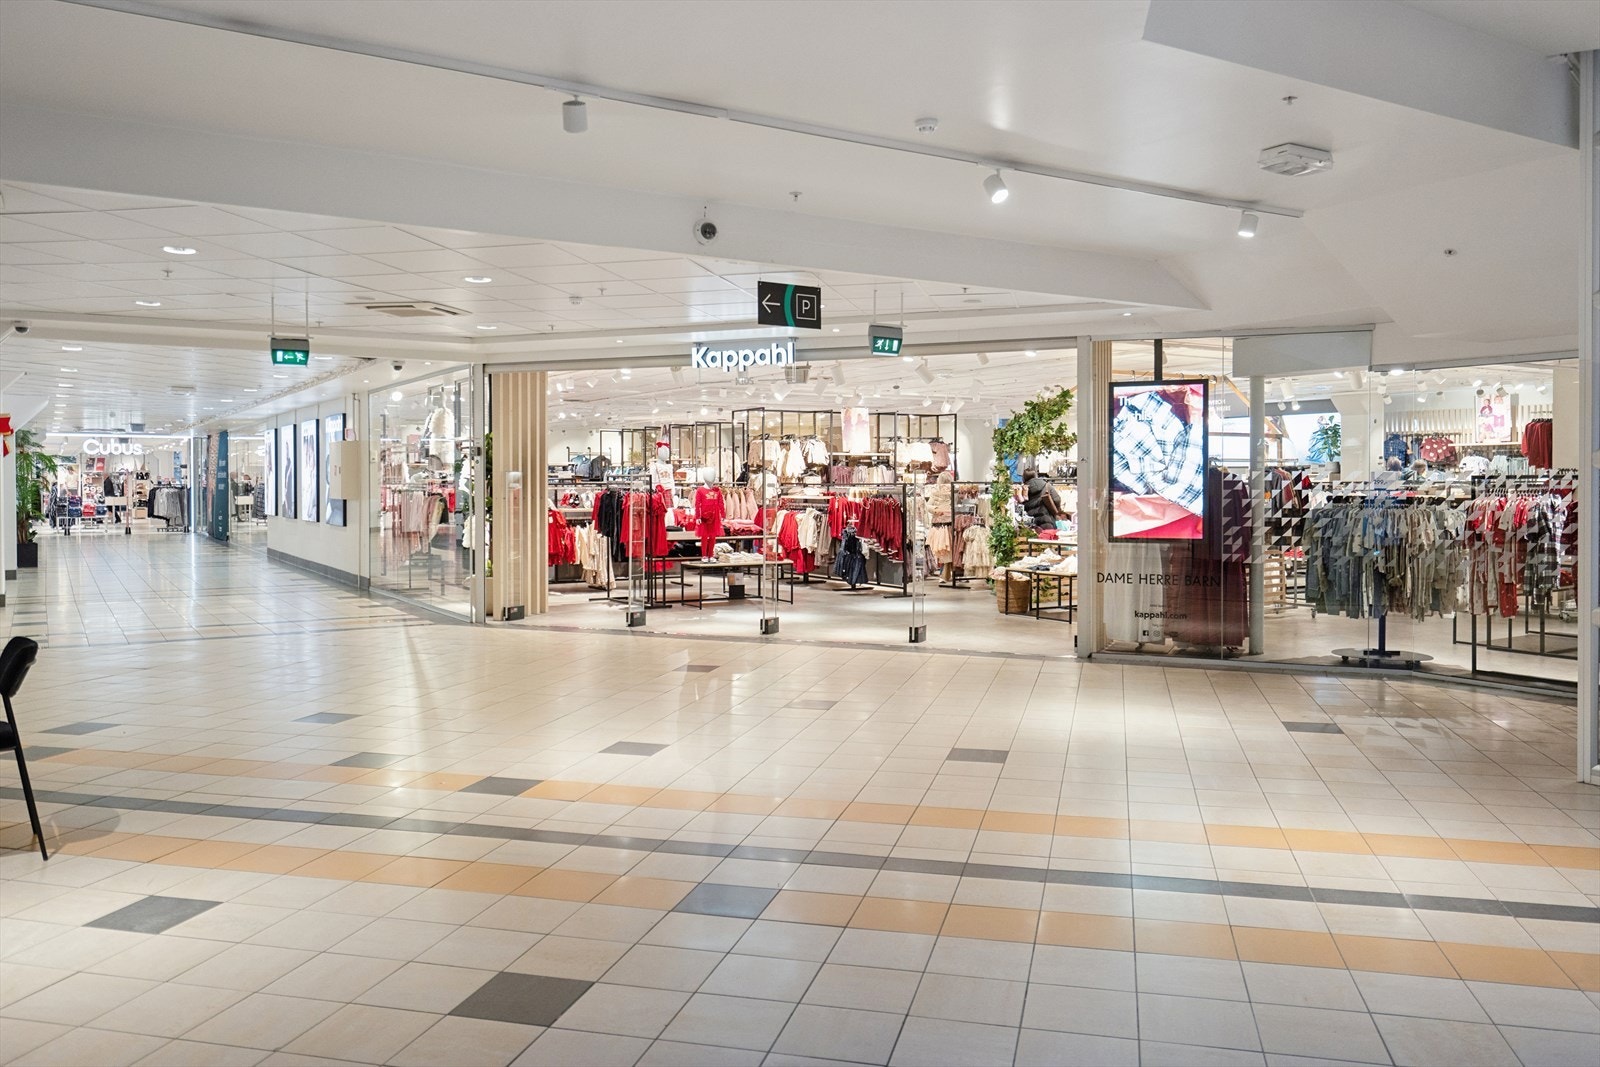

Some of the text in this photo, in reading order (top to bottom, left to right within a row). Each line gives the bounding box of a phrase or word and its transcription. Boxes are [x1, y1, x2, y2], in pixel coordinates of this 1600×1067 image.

[691, 342, 796, 373] Kappahl
[83, 438, 143, 455] Cubus
[1096, 572, 1222, 587] DAME HERRE BARN
[1134, 611, 1188, 621] kappahl.com
